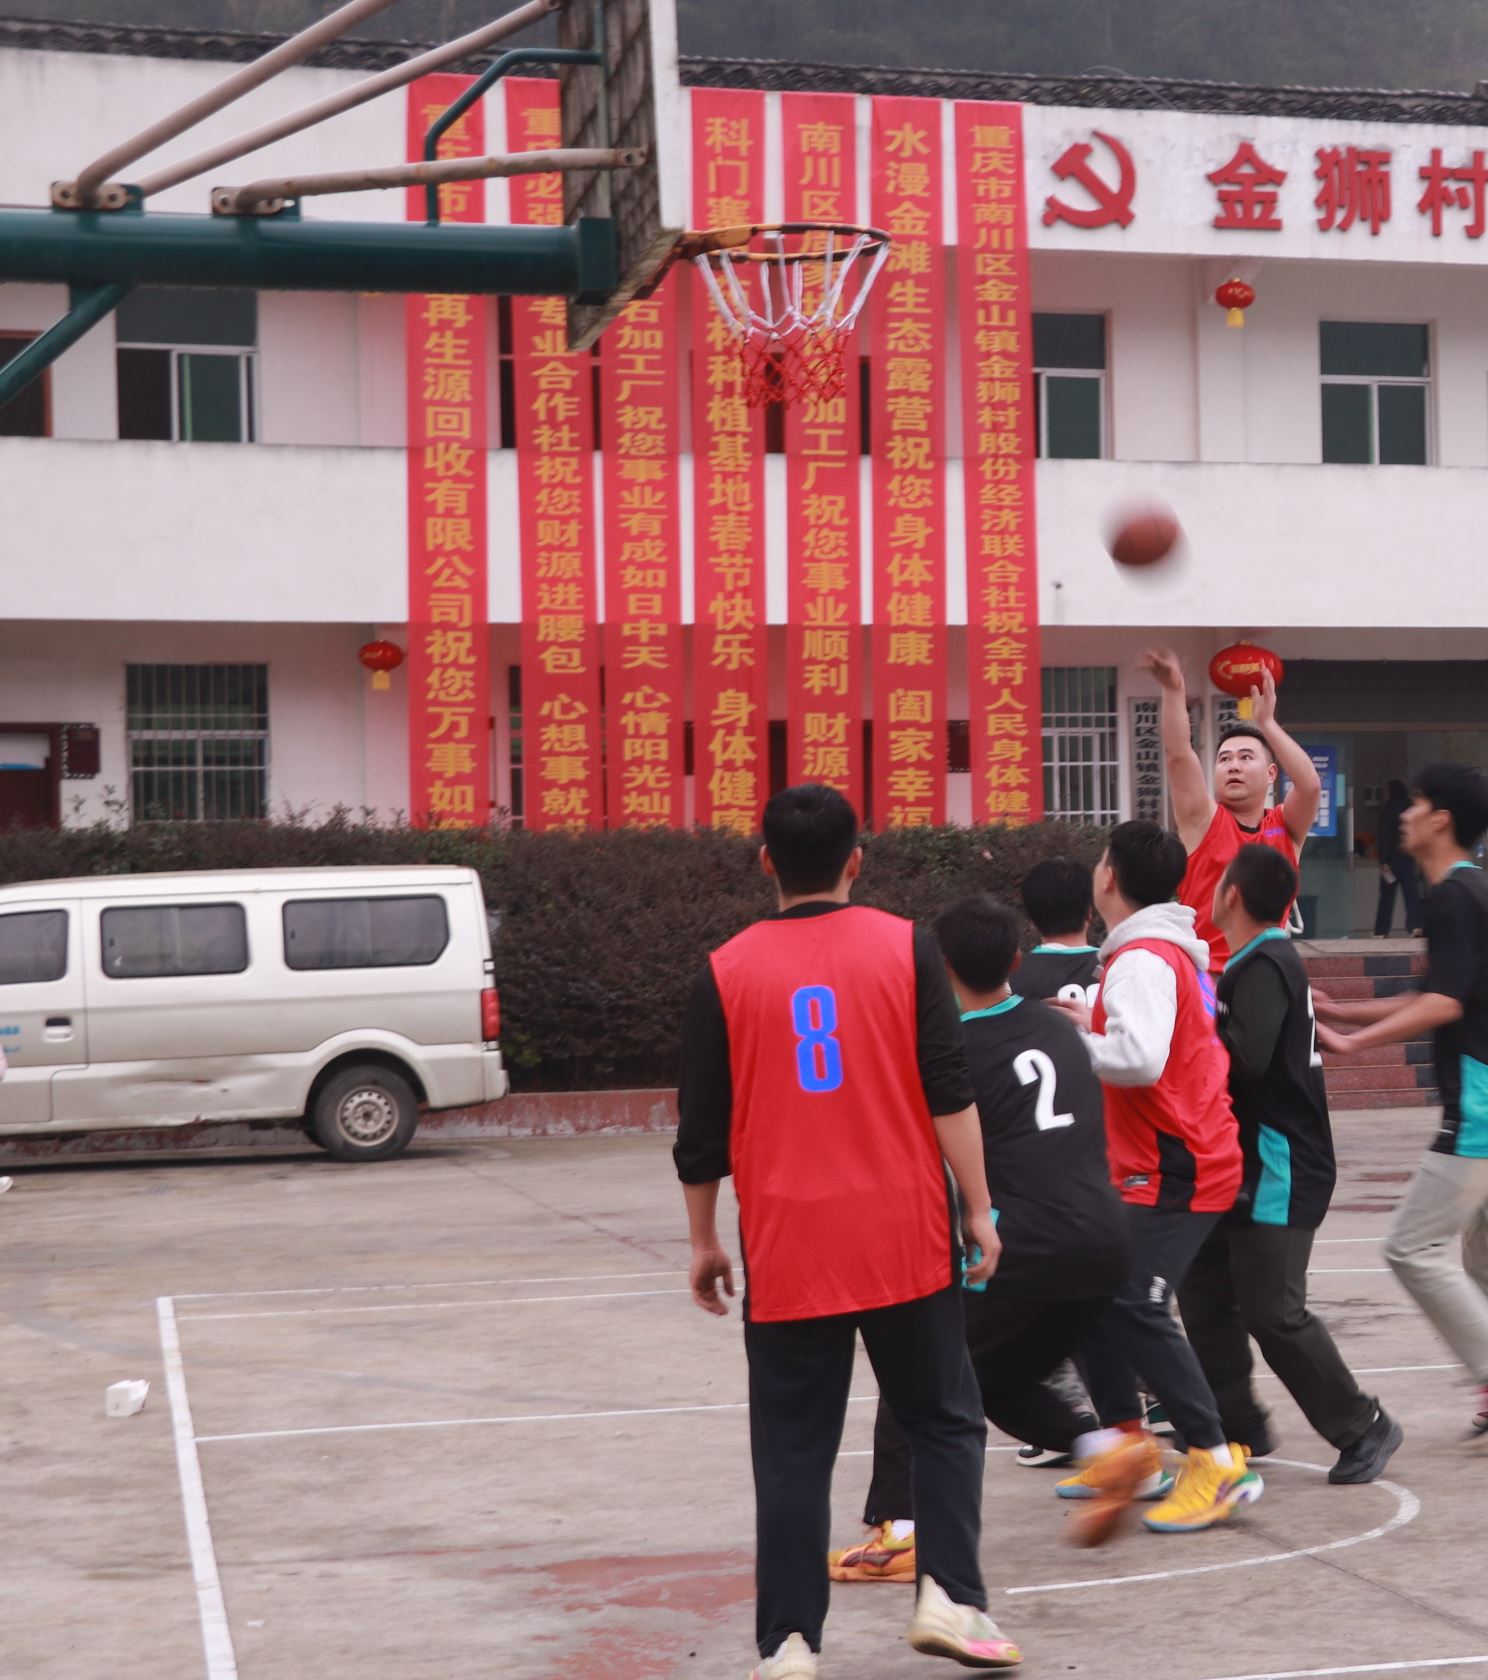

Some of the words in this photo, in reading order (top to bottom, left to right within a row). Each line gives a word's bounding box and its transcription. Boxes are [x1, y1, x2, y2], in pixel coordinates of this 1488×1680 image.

[884, 122, 934, 665] 水漫金滩生态露营祝您身体健康
[614, 286, 671, 669] 石加工厂祝您事业有成如日中天
[803, 713, 851, 790] 财源
[887, 688, 934, 828] 阖家幸福
[792, 984, 844, 1093] 8
[1012, 1048, 1076, 1131] 2
